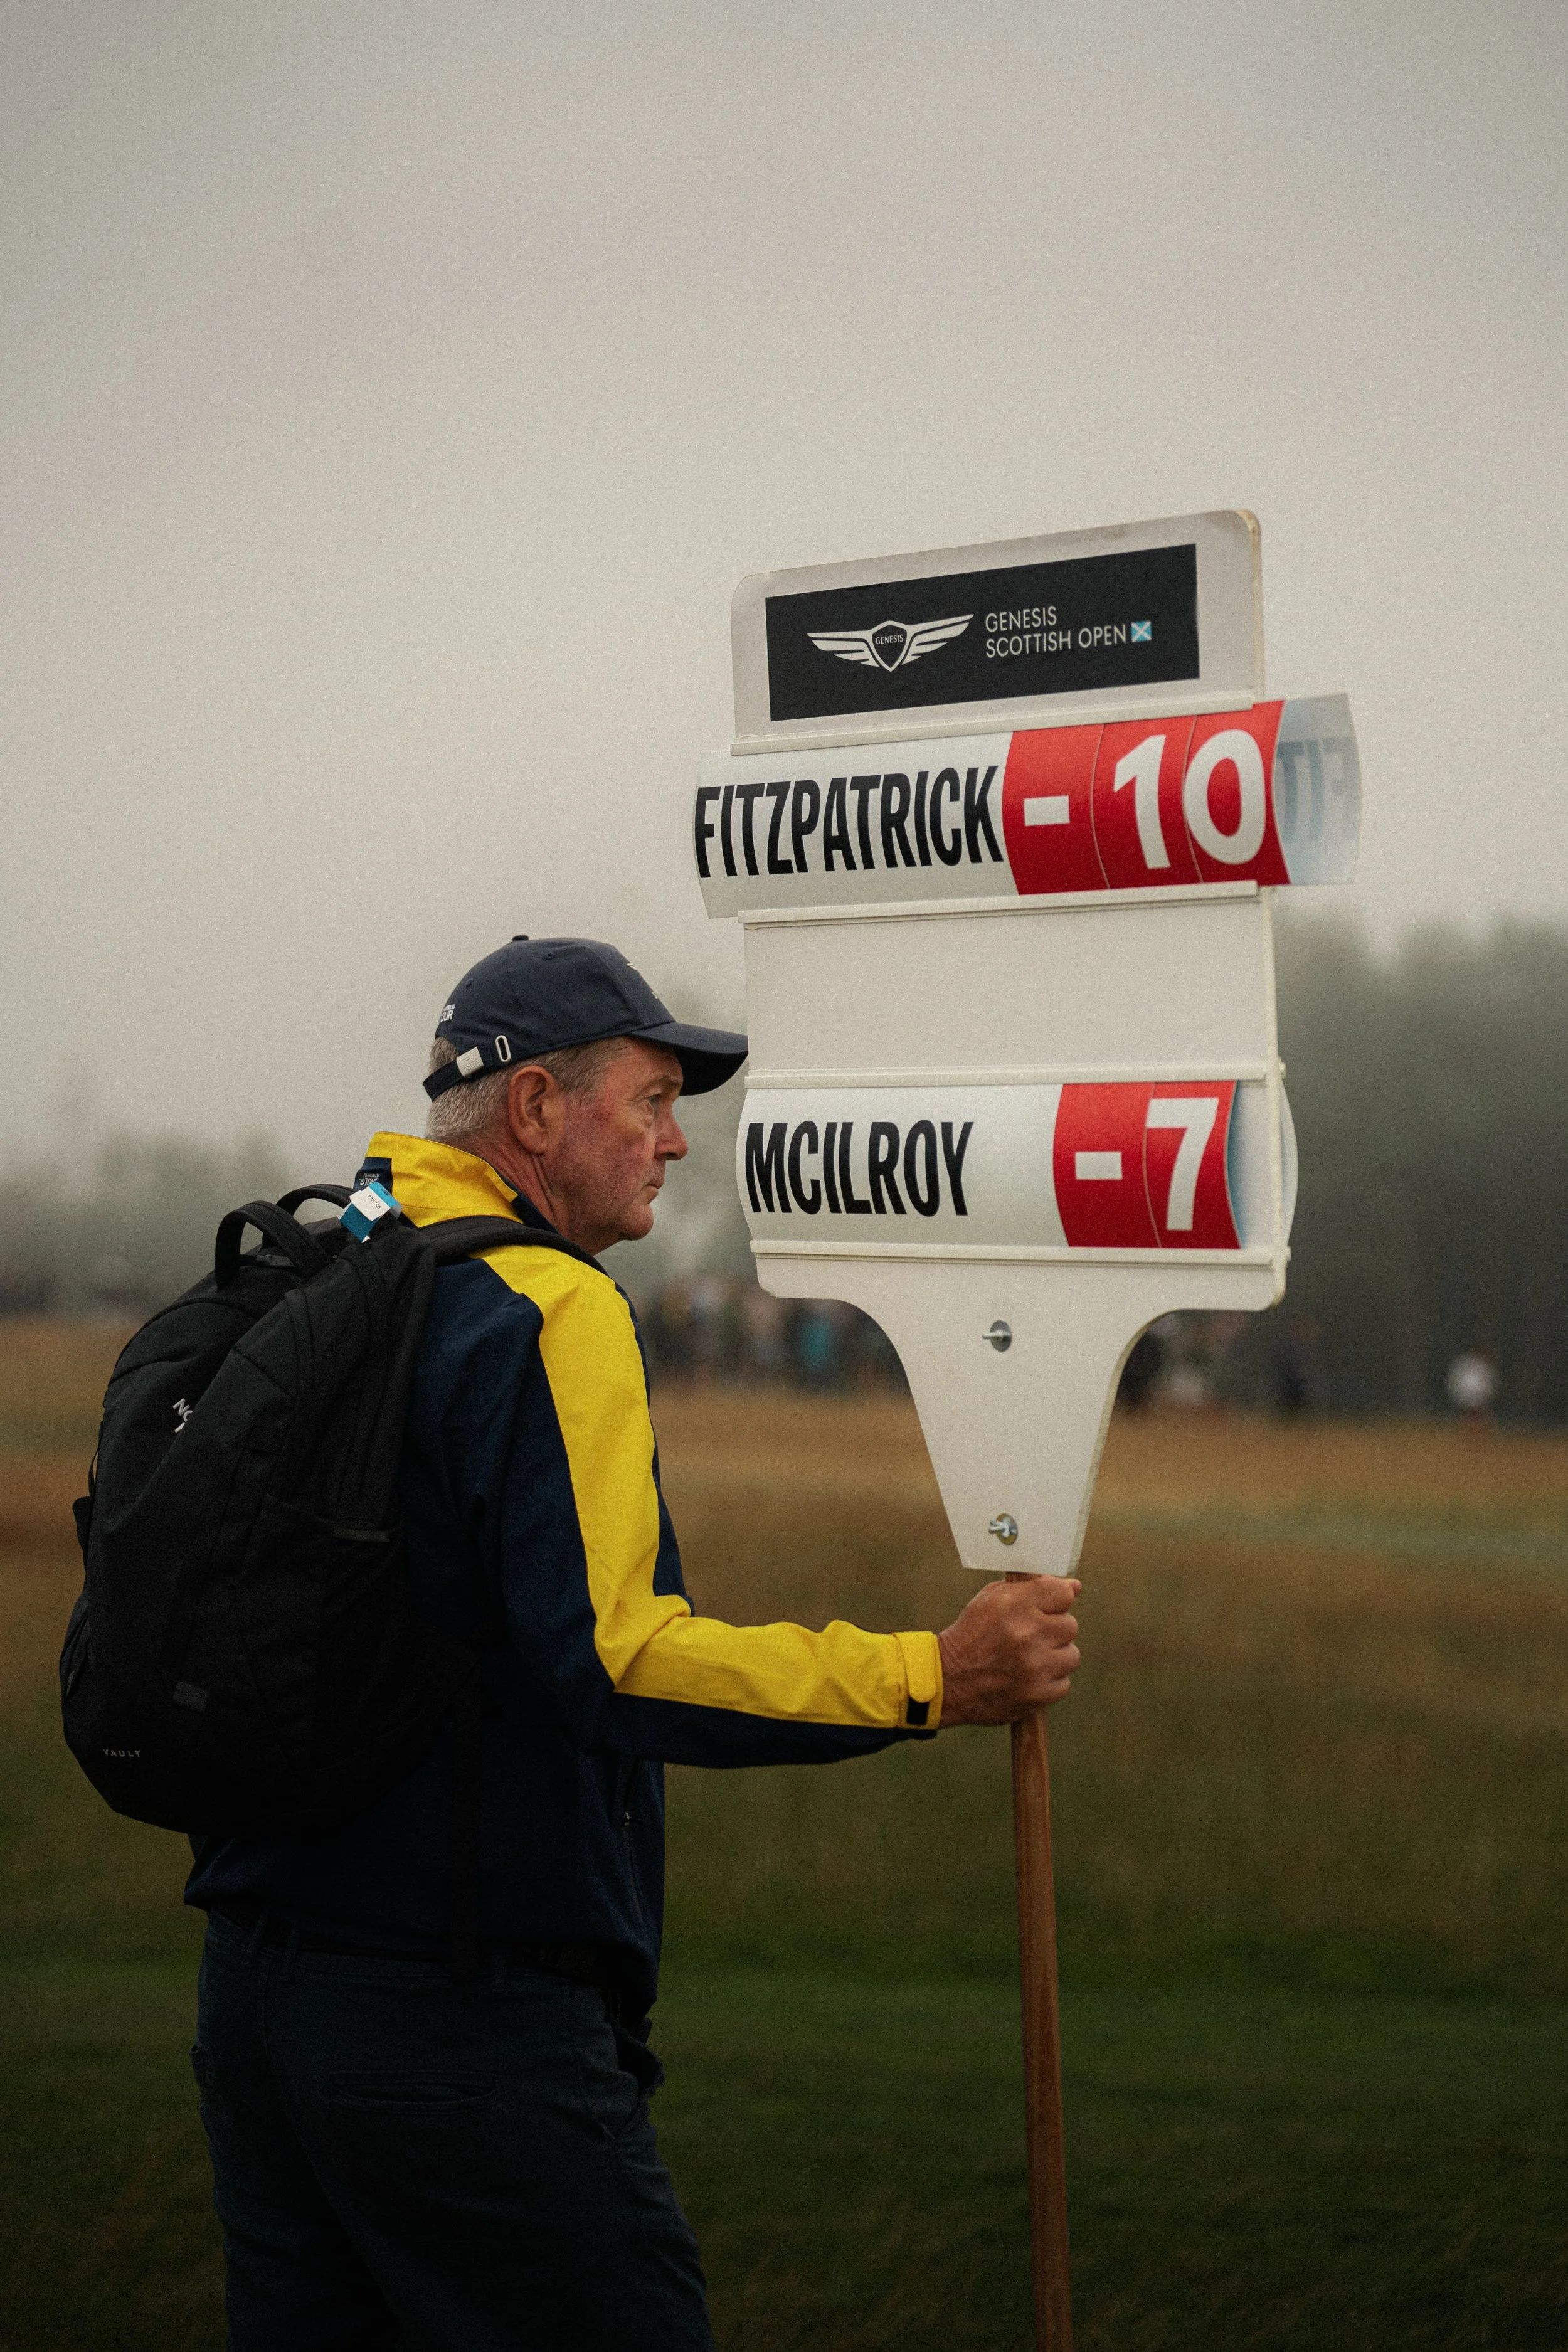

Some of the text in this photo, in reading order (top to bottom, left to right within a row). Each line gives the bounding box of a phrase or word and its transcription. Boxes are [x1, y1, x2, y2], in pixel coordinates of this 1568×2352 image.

[985, 605, 1057, 633] GENESIS
[875, 633, 904, 645] GENESIS
[987, 623, 1127, 659] SCOTTISH OPEN
[694, 765, 1004, 878] FITZPATRICK
[745, 1097, 1219, 1231] MCILROY -7
[102, 1749, 140, 1757] VAULT
